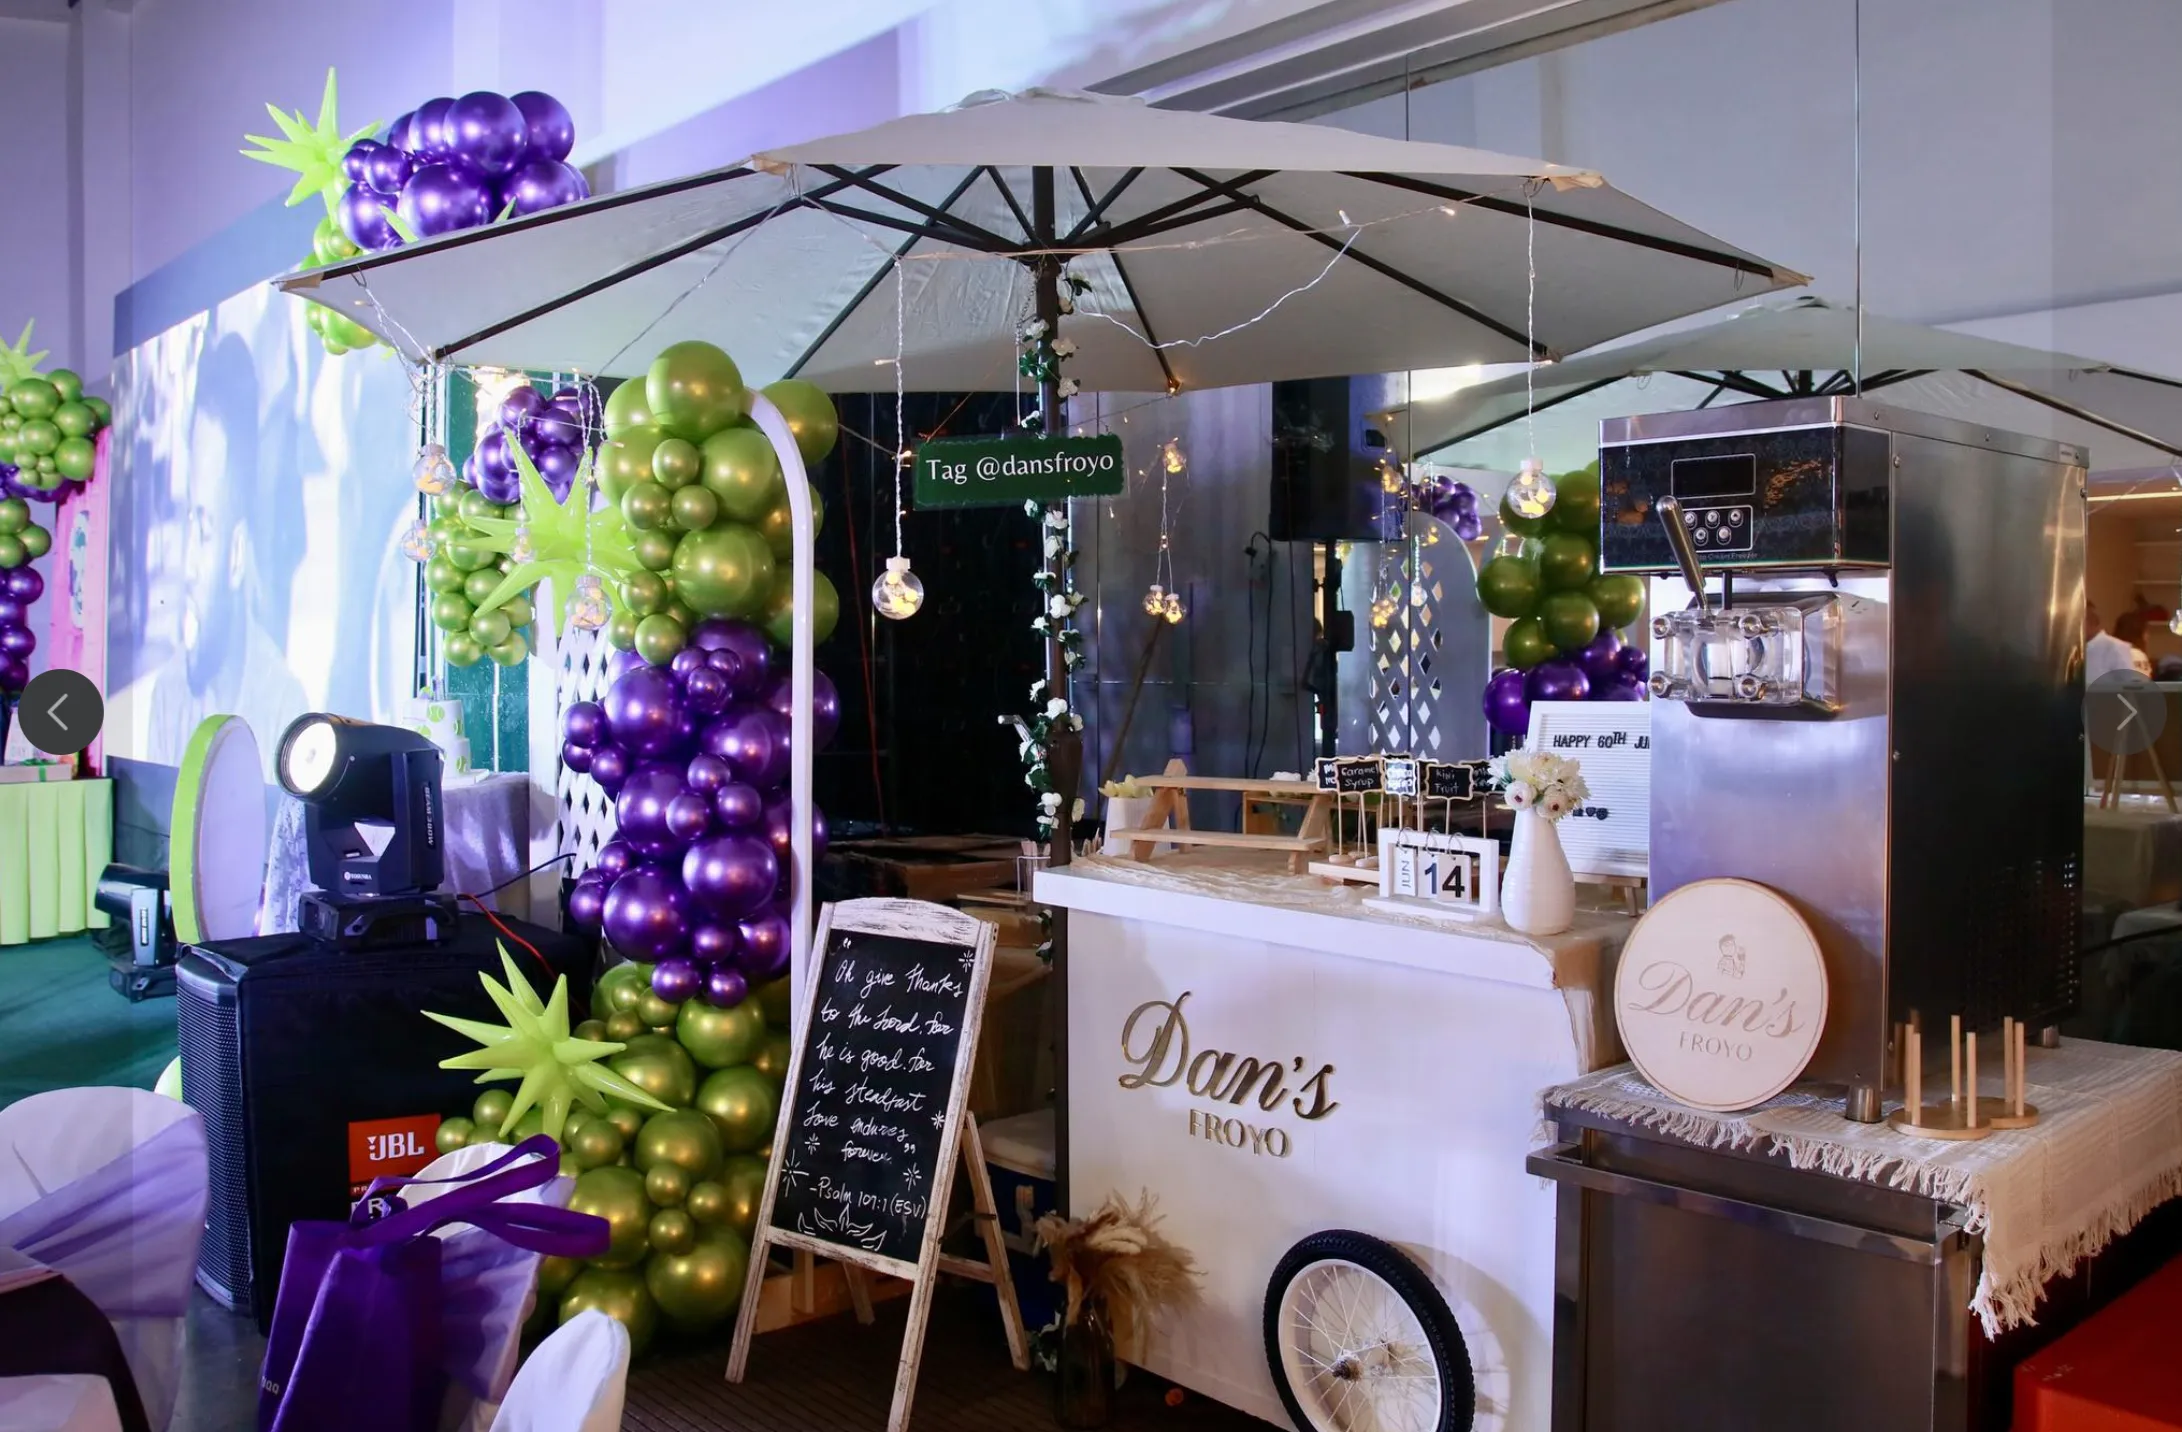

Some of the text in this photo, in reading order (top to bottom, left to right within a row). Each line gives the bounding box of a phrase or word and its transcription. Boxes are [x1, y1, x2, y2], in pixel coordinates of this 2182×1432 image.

[925, 451, 1114, 485] Tag @dansfroyo
[1553, 734, 1591, 748] HAPPY
[1597, 731, 1627, 749] 60TH
[1401, 860, 1412, 888] JUN
[835, 959, 855, 983] Oh
[860, 968, 895, 999] give
[821, 997, 840, 1022] to
[848, 1003, 872, 1029] the
[1628, 960, 1805, 1038] Dan's
[839, 1042, 855, 1064] is
[1118, 990, 1338, 1120] Dan's
[1679, 1030, 1753, 1061] FROYO
[809, 1068, 927, 1112] his steadfast
[850, 1117, 909, 1142] endures
[1189, 1108, 1290, 1158] FROYO
[368, 1131, 425, 1161] JBL
